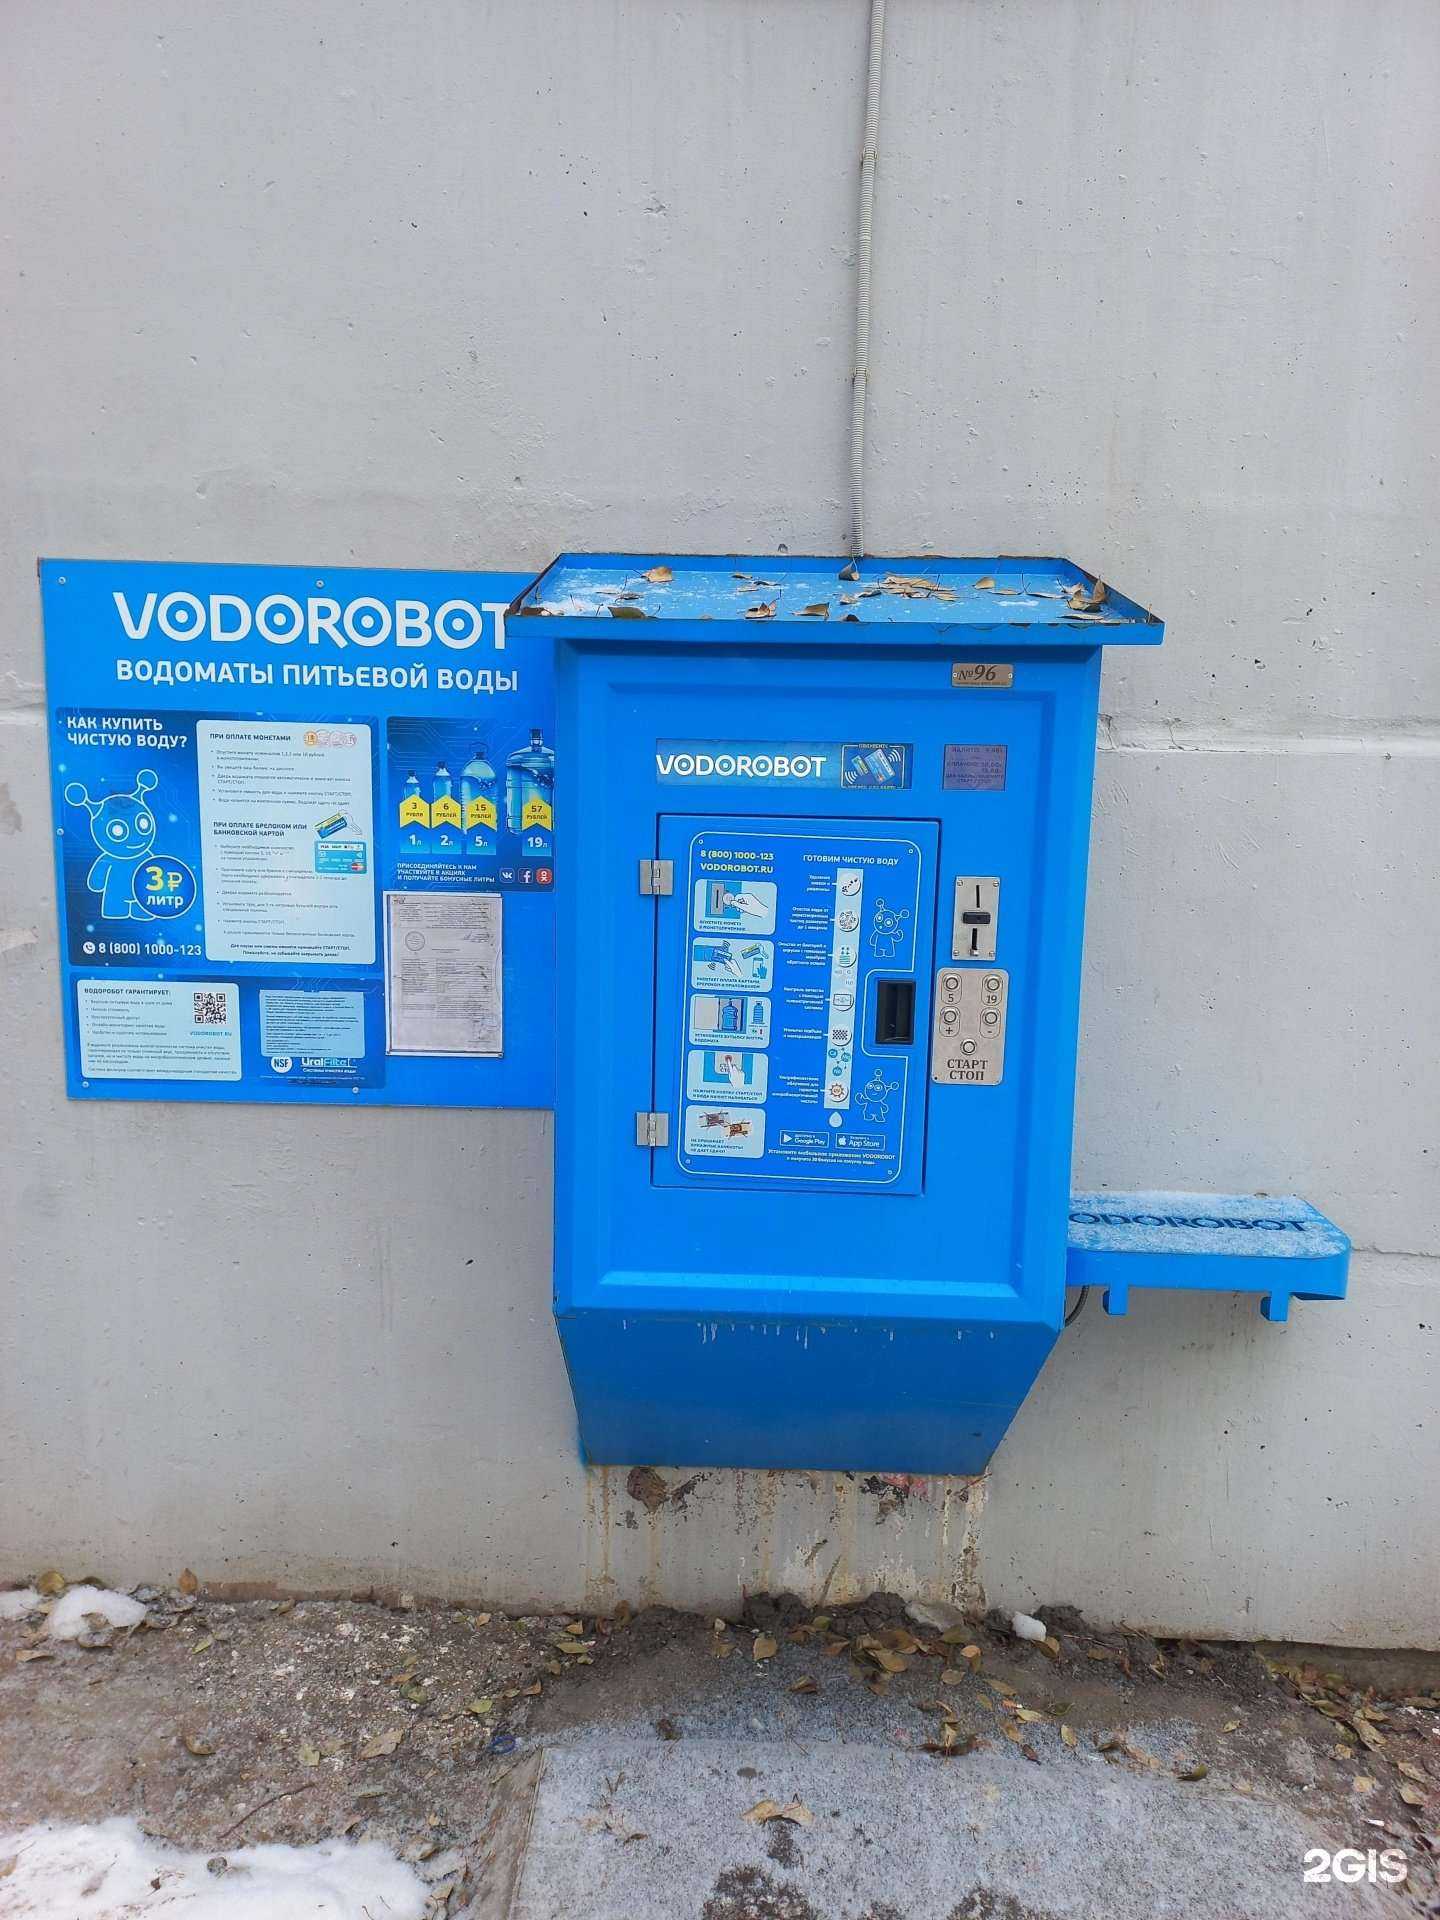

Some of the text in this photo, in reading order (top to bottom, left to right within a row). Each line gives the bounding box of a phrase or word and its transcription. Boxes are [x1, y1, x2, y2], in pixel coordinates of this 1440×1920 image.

[112, 591, 510, 650] VODOROBOT
[116, 659, 518, 695] ВОДОМАТЫ ПИТЬЕВОЙ ВОДЫ
[67, 716, 163, 731] КАК КУПИТЬ
[67, 732, 188, 750] ЧИСТУЮ ВОДУ?
[655, 754, 827, 778] VODOROBOT
[411, 802, 418, 810] 3
[475, 803, 486, 811] 15
[531, 805, 543, 813] 57
[700, 850, 774, 861] 8 (800) 1000-123
[803, 854, 899, 866] ГОТОВИМ ЧИСТУЮ ВОДУ
[397, 862, 457, 870] ПРИСОЕДИНЯЙТЕСЬ
[700, 863, 774, 874] VODOROBOT.RU
[146, 895, 184, 909] литр
[98, 942, 202, 956] 8 (800) 1000-123
[84, 987, 123, 995] ВОДОРОБОТ
[948, 993, 954, 1003] 5
[986, 994, 998, 1004] 19
[273, 1058, 289, 1068] NSF
[947, 1059, 989, 1070] СТАРТ
[949, 1070, 985, 1081] СТОП
[794, 1137, 813, 1145] Google
[1068, 1212, 1308, 1232] ODOROBOT
